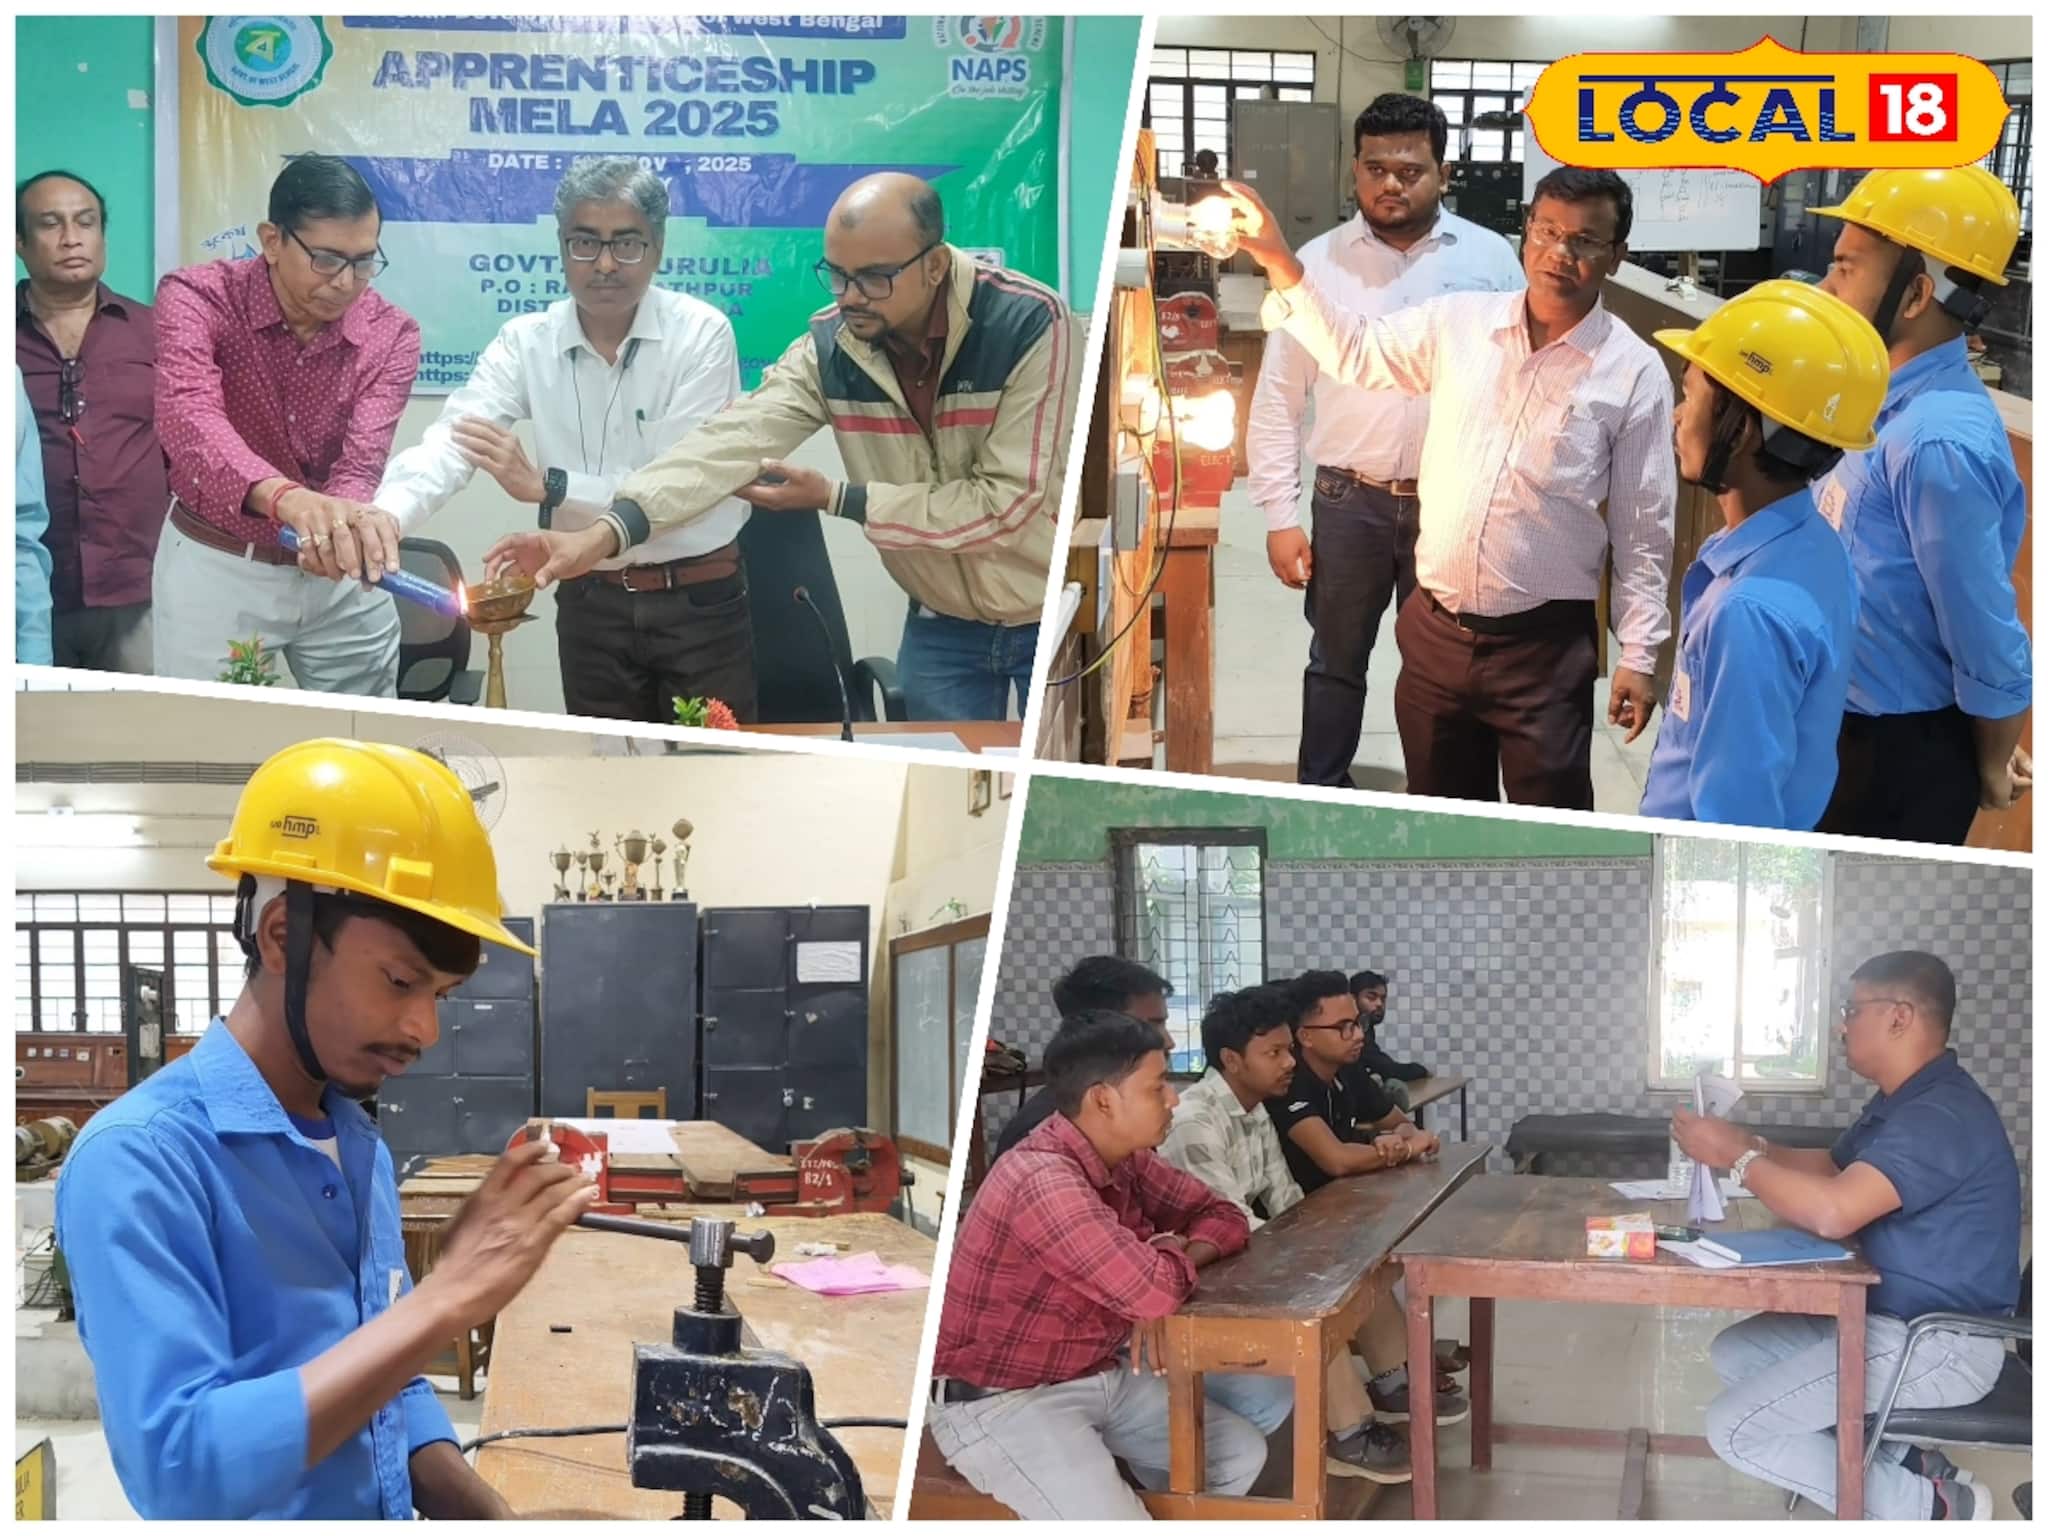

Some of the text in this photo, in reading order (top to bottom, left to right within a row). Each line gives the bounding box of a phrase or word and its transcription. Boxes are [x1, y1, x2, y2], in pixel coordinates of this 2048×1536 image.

[372, 50, 875, 94] APPRENTICESHIP
[951, 57, 1027, 82] NAPS
[469, 97, 780, 136] MELA 2025
[488, 153, 549, 170] DATE
[697, 156, 752, 172] 2025
[656, 256, 773, 275] URULIA
[481, 280, 521, 294] P.O
[283, 816, 316, 839] hmp
